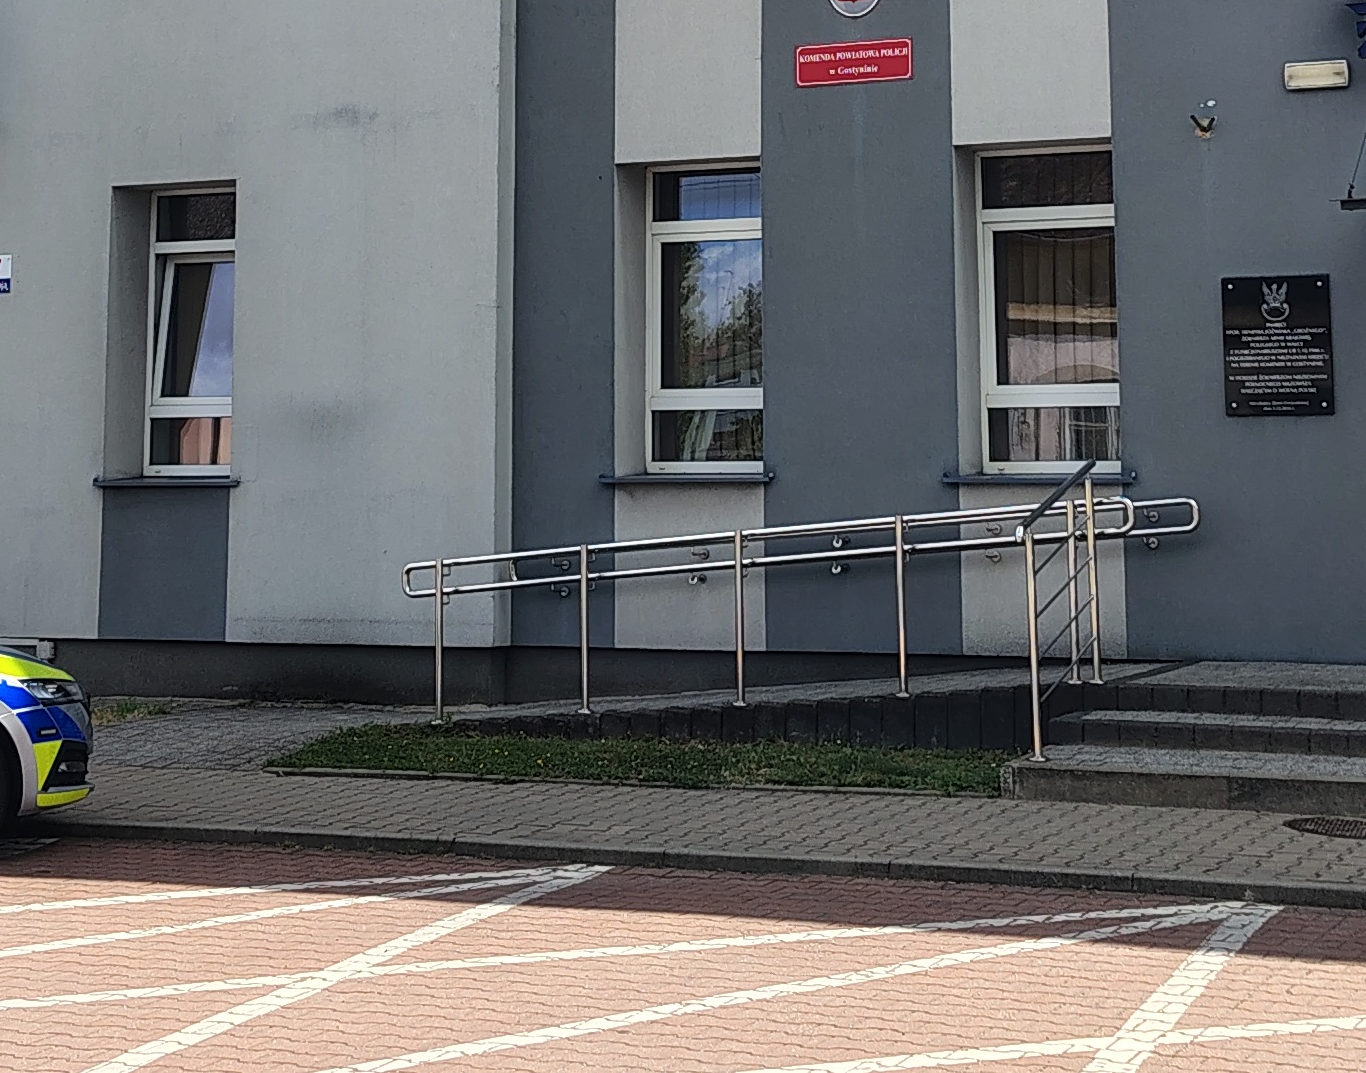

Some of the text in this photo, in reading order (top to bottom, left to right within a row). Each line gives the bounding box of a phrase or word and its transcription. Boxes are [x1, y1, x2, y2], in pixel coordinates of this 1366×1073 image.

[799, 47, 908, 63] KOMENDA POWIATOWA POLICJI
[837, 65, 879, 76] Gostyninie
